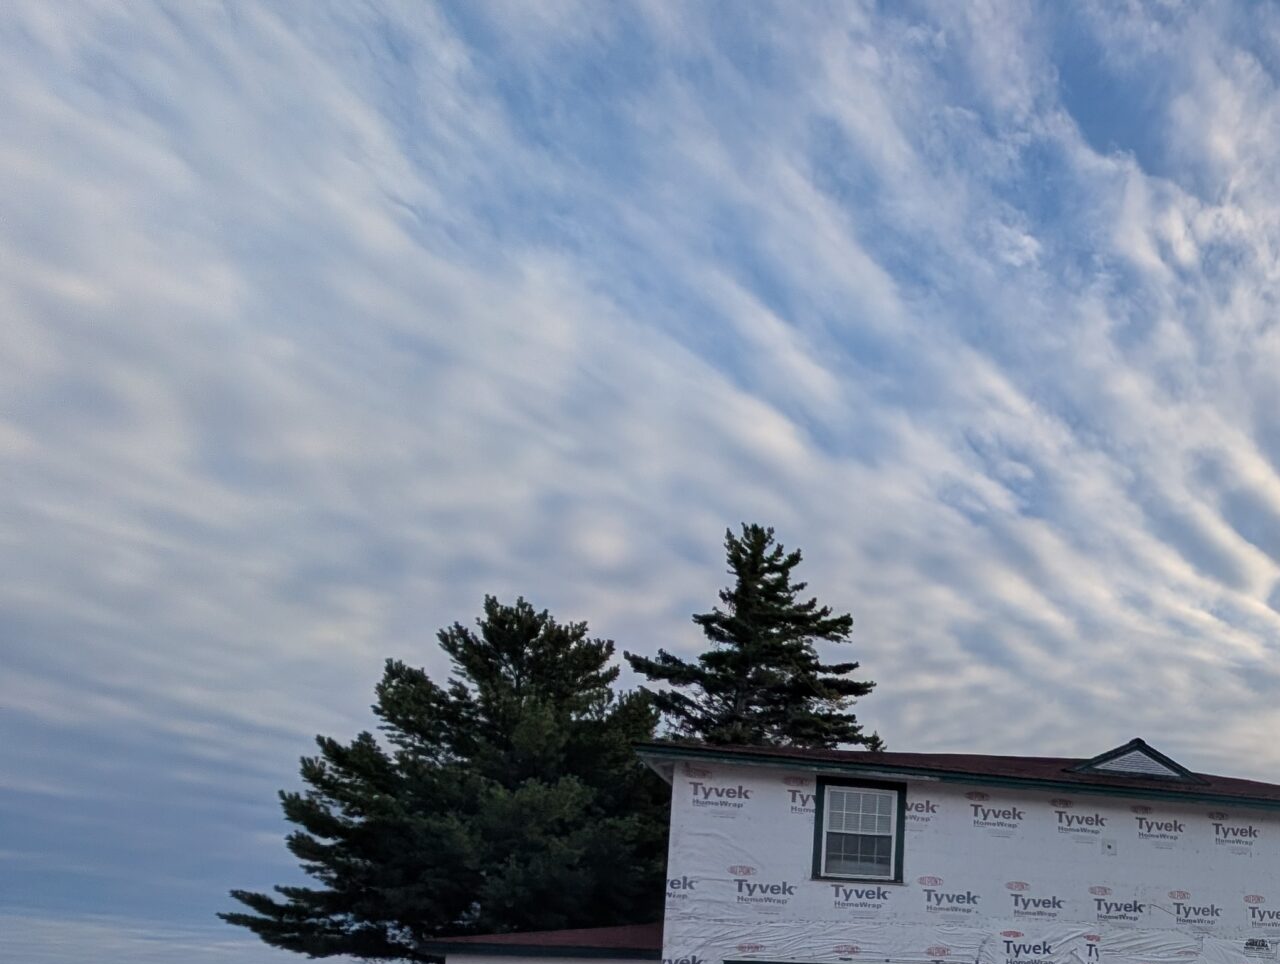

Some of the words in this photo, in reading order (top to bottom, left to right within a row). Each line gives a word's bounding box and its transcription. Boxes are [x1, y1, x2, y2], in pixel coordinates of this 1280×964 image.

[689, 782, 751, 800] Tyvek
[787, 789, 816, 807] Tyv
[905, 801, 937, 814] vek
[970, 803, 1023, 820] Tyvek
[1055, 810, 1105, 827] Tyvek
[1135, 817, 1183, 833] Tyvek
[1212, 823, 1258, 839] Tyvek
[733, 878, 794, 897] Tyvek
[831, 884, 889, 901] Tyvek
[923, 889, 978, 906] Tyvek
[1011, 893, 1062, 910] Tyvek
[1093, 898, 1144, 914] Tyvek
[1173, 902, 1220, 918] Tyvek
[1003, 940, 1052, 958] Tyvek
